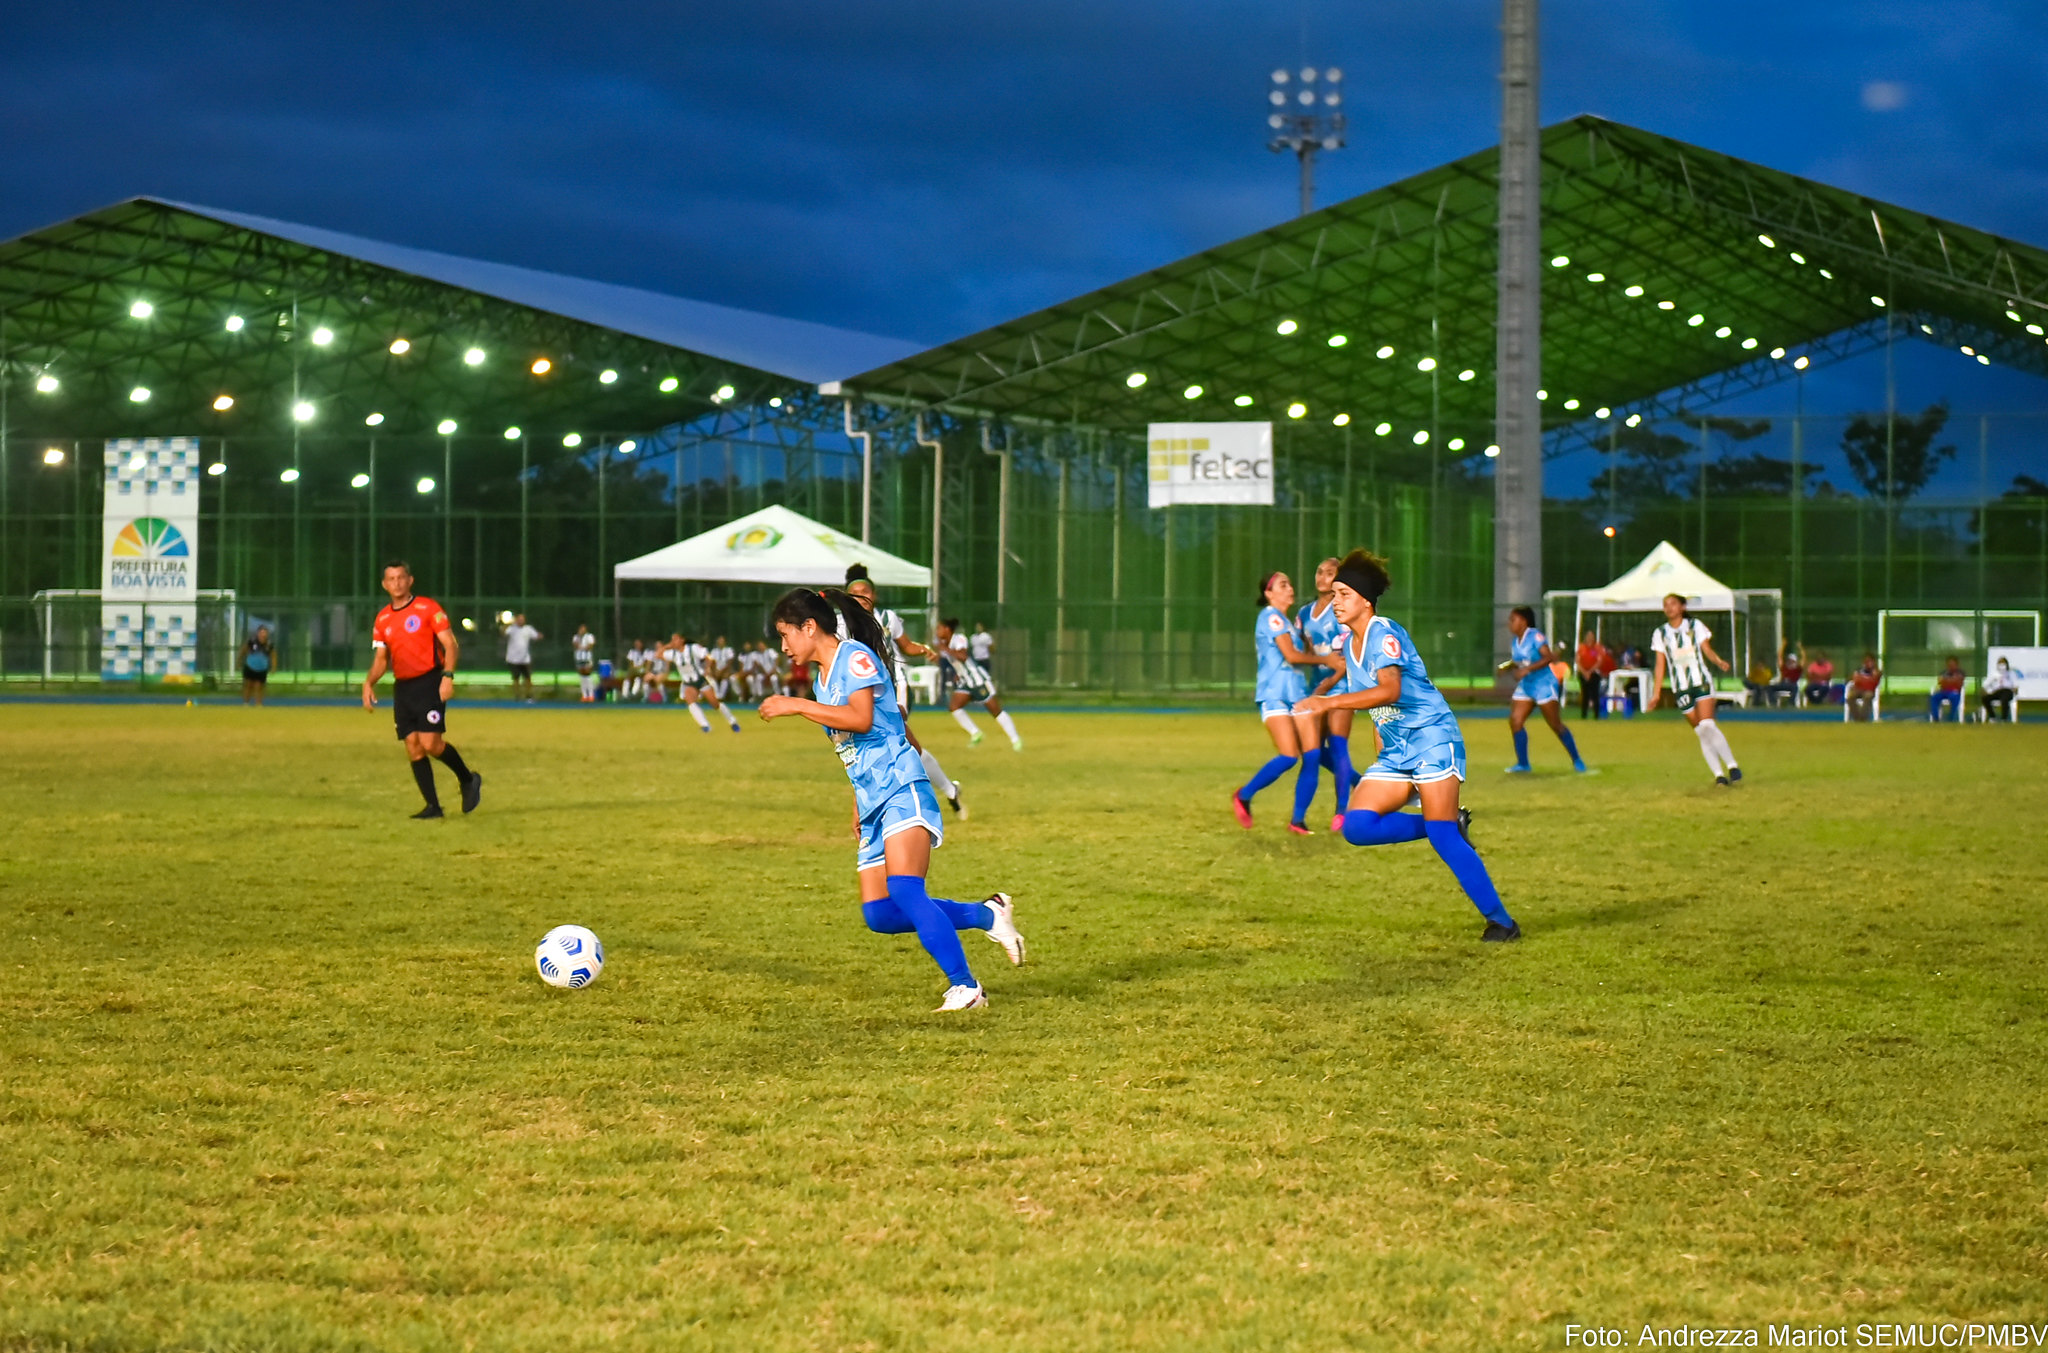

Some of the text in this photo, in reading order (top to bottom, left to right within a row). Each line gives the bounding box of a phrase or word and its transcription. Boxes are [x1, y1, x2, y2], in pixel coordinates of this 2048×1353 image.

[1190, 452, 1269, 480] fetec
[112, 560, 187, 573] PREFEITURA
[112, 574, 186, 588] BOA VISTA
